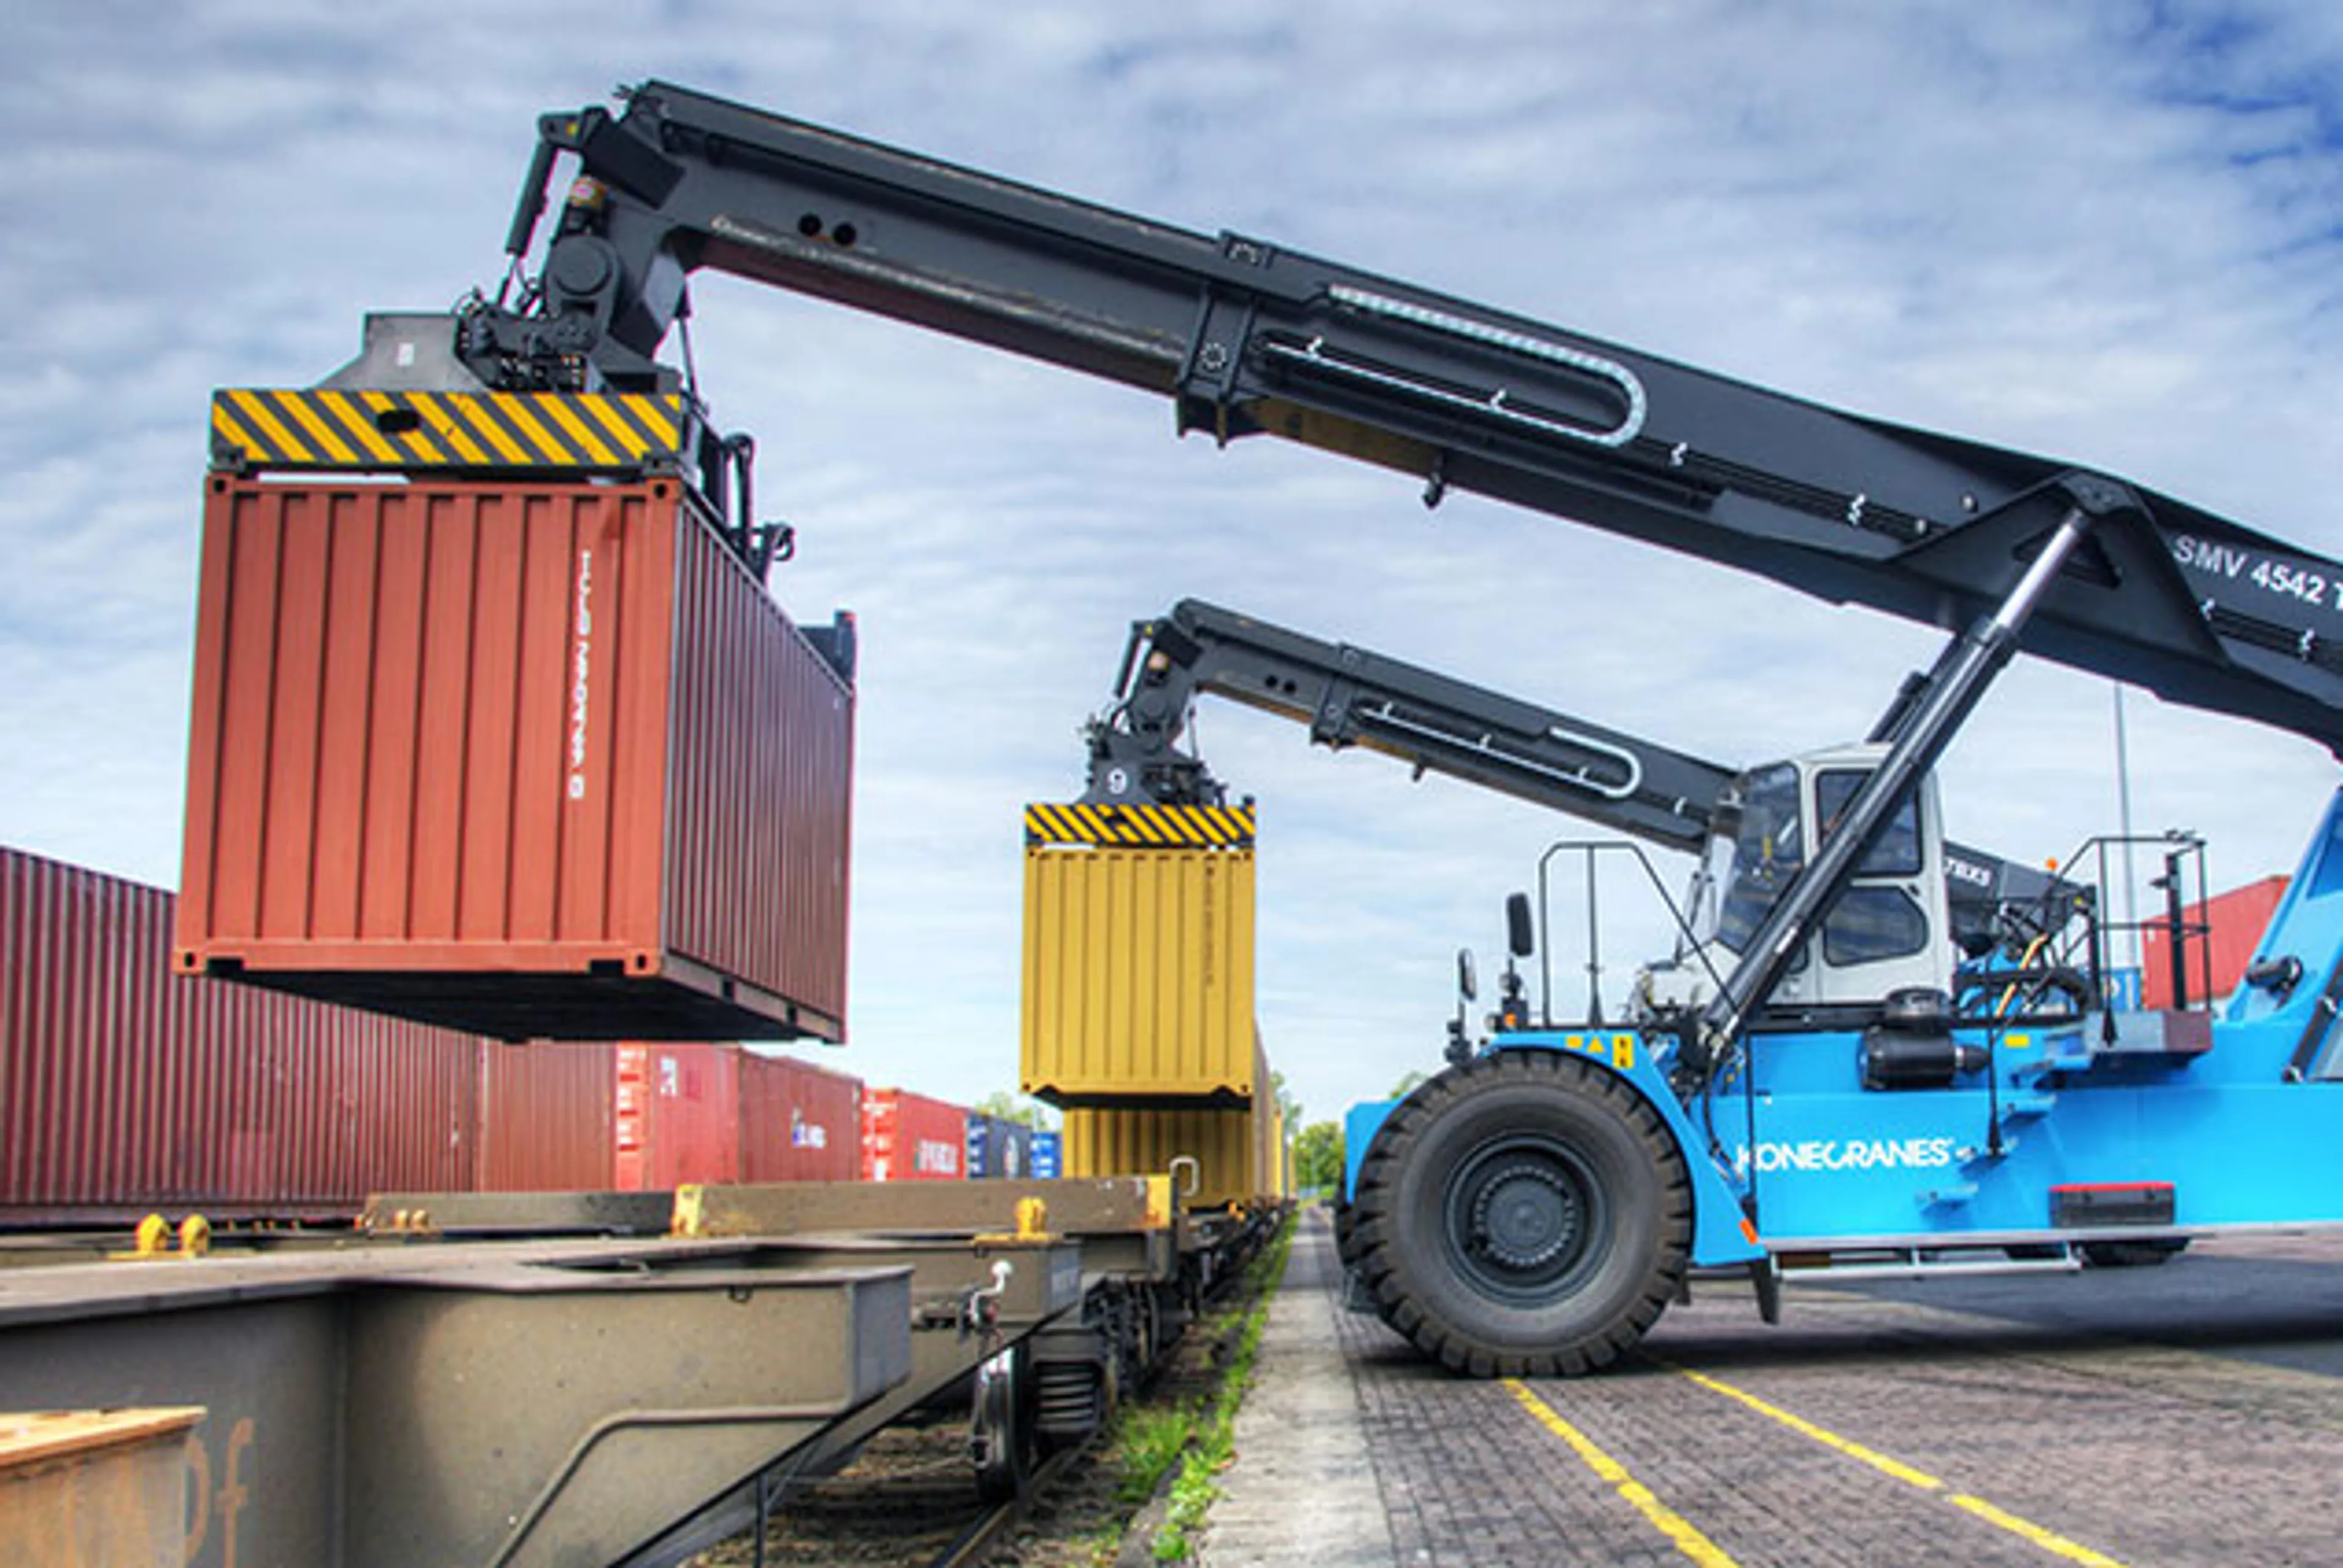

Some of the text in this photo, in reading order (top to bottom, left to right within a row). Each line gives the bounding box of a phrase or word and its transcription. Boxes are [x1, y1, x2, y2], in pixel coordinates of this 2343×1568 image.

[2173, 534, 2248, 578] SMV
[2251, 560, 2326, 605] 4542
[1109, 767, 1127, 794] 9
[1737, 1139, 1951, 1171] KONECRANES
